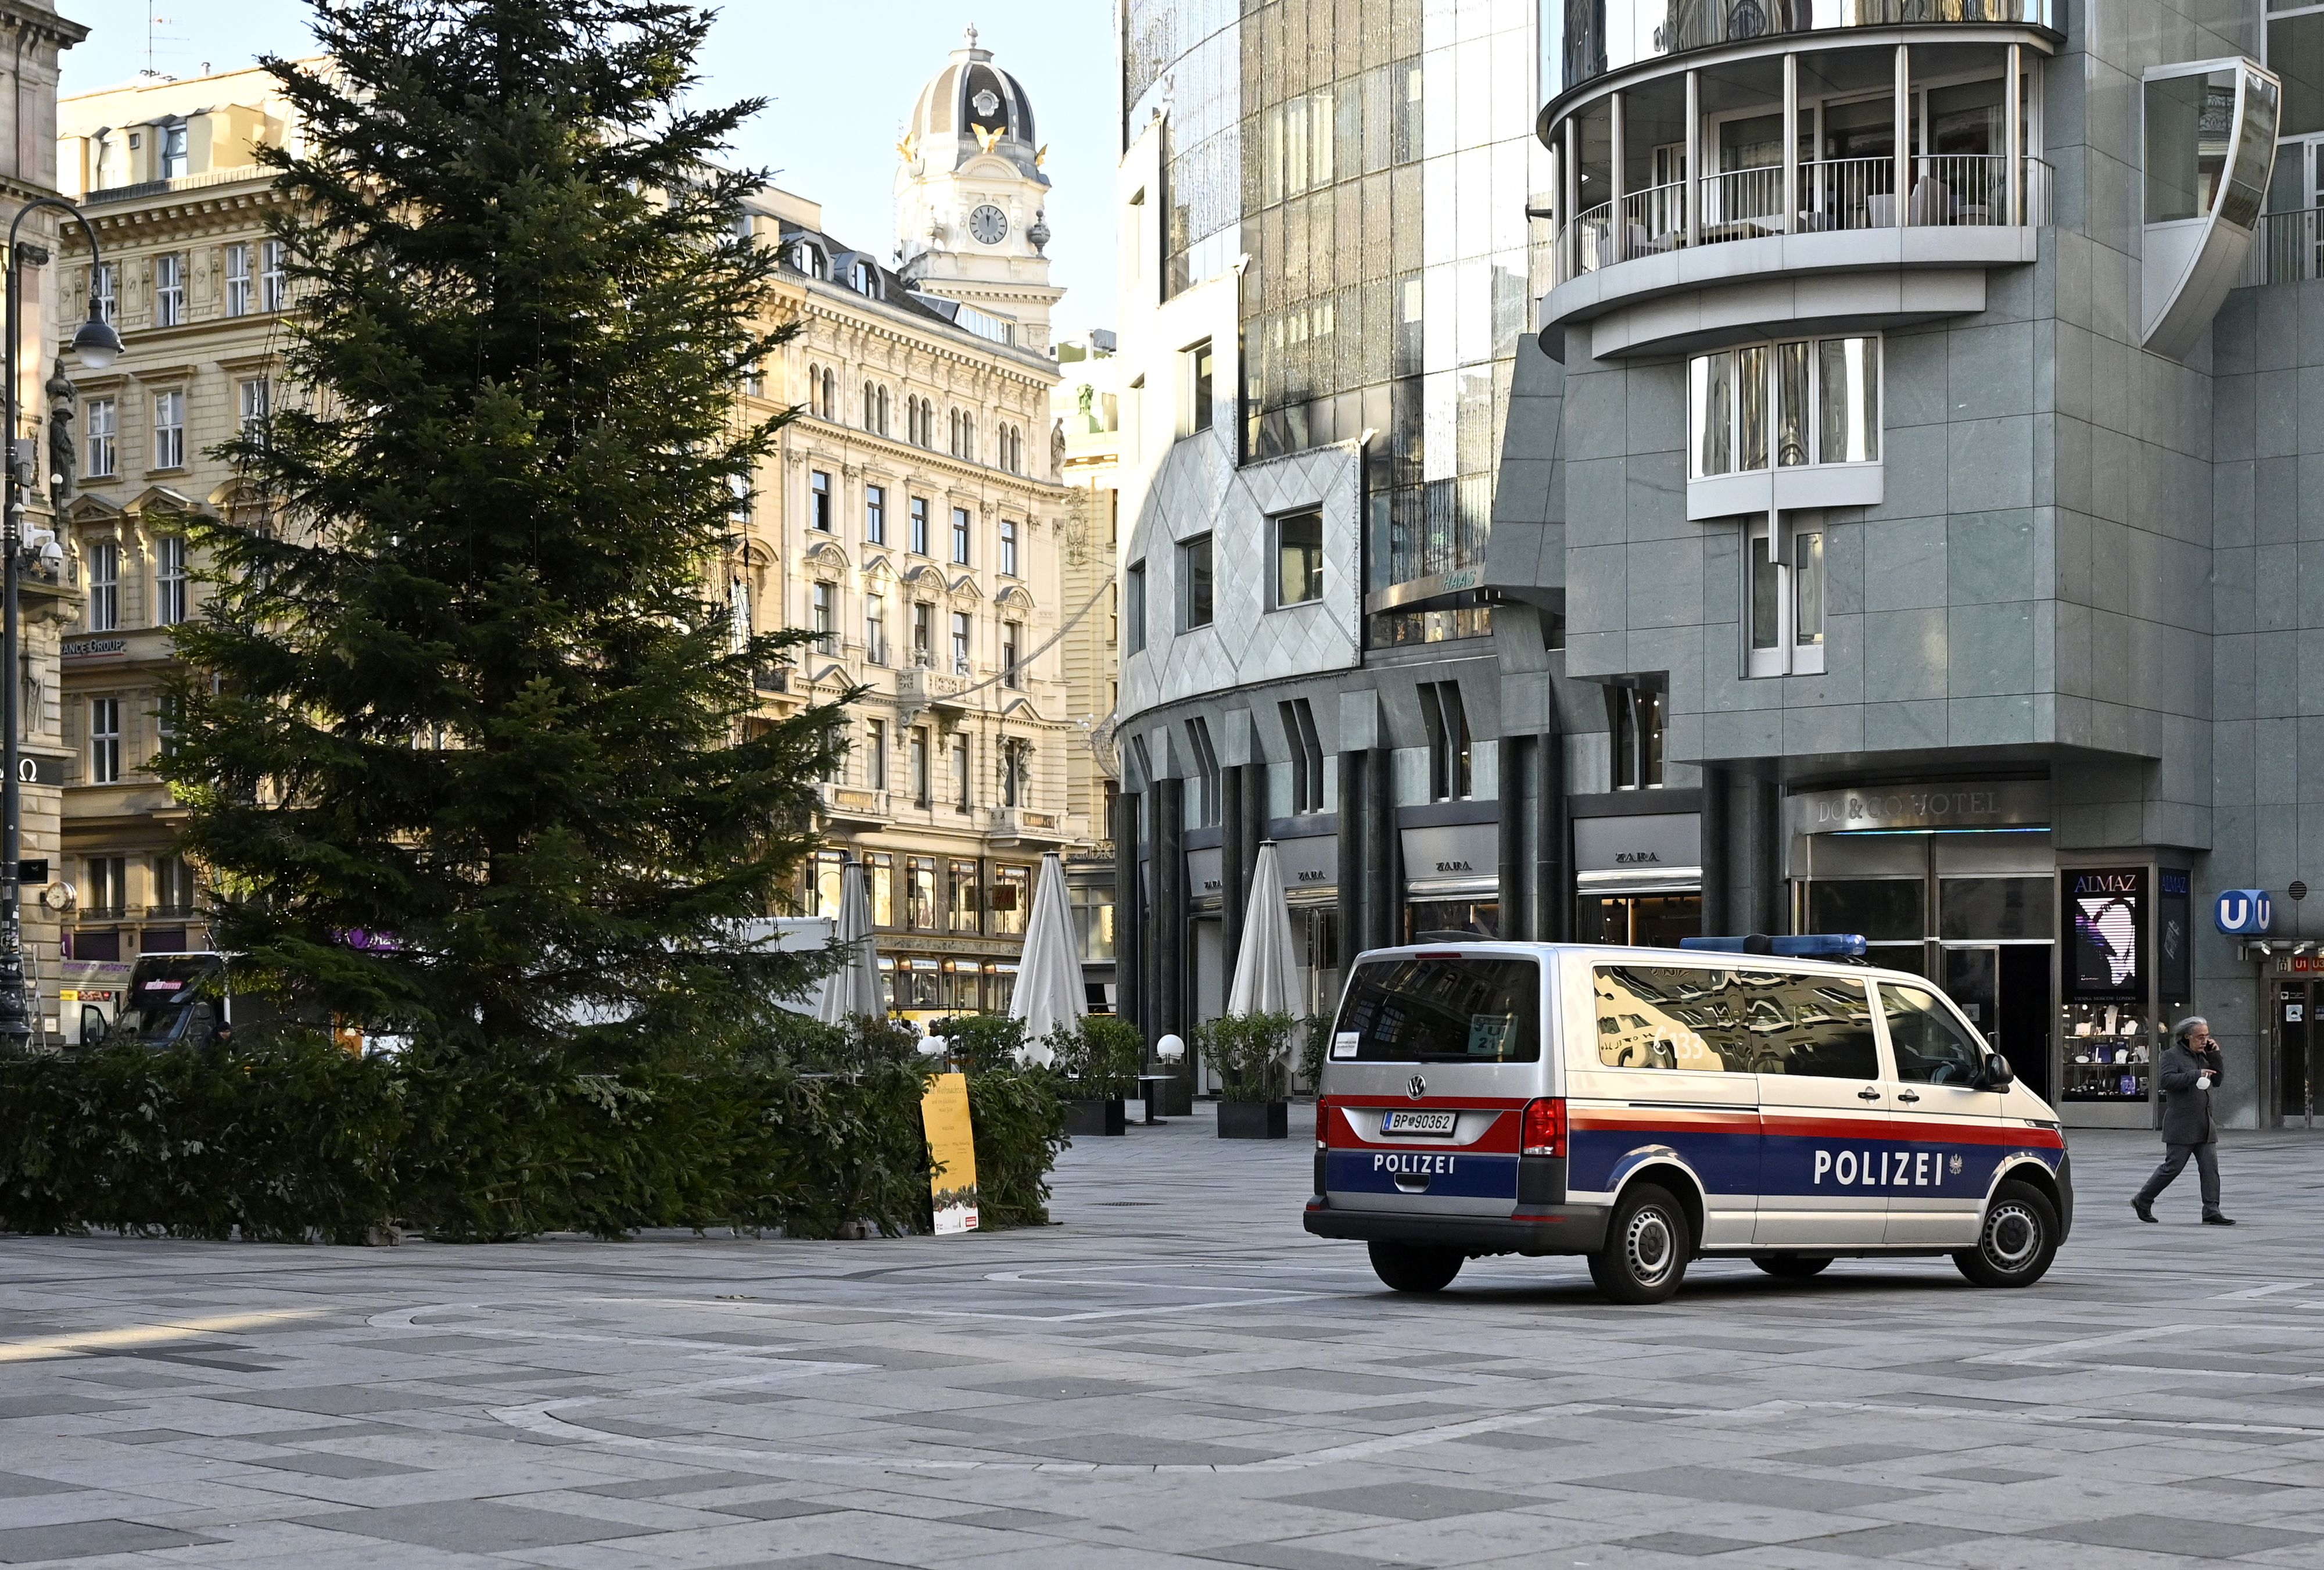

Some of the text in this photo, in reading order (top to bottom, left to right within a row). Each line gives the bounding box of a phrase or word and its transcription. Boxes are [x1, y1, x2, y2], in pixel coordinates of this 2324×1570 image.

[1443, 569, 1476, 591] HAAS
[1911, 793, 2002, 816] HOTEL
[1436, 861, 1472, 871] ZARA
[1615, 852, 1660, 863] ZARA
[1298, 870, 1326, 881] ZARA
[2074, 874, 2136, 892] ALMAZ
[2161, 874, 2186, 893] ALMAZ
[2221, 899, 2247, 930] U
[2258, 899, 2270, 930] U
[2296, 960, 2306, 968] U1
[2312, 959, 2324, 968] U3
[1669, 1032, 1703, 1059] 133
[1414, 1114, 1450, 1129] 90362
[1374, 1154, 1455, 1174] POLIZEI
[1814, 1150, 1942, 1186] POLIZEI
